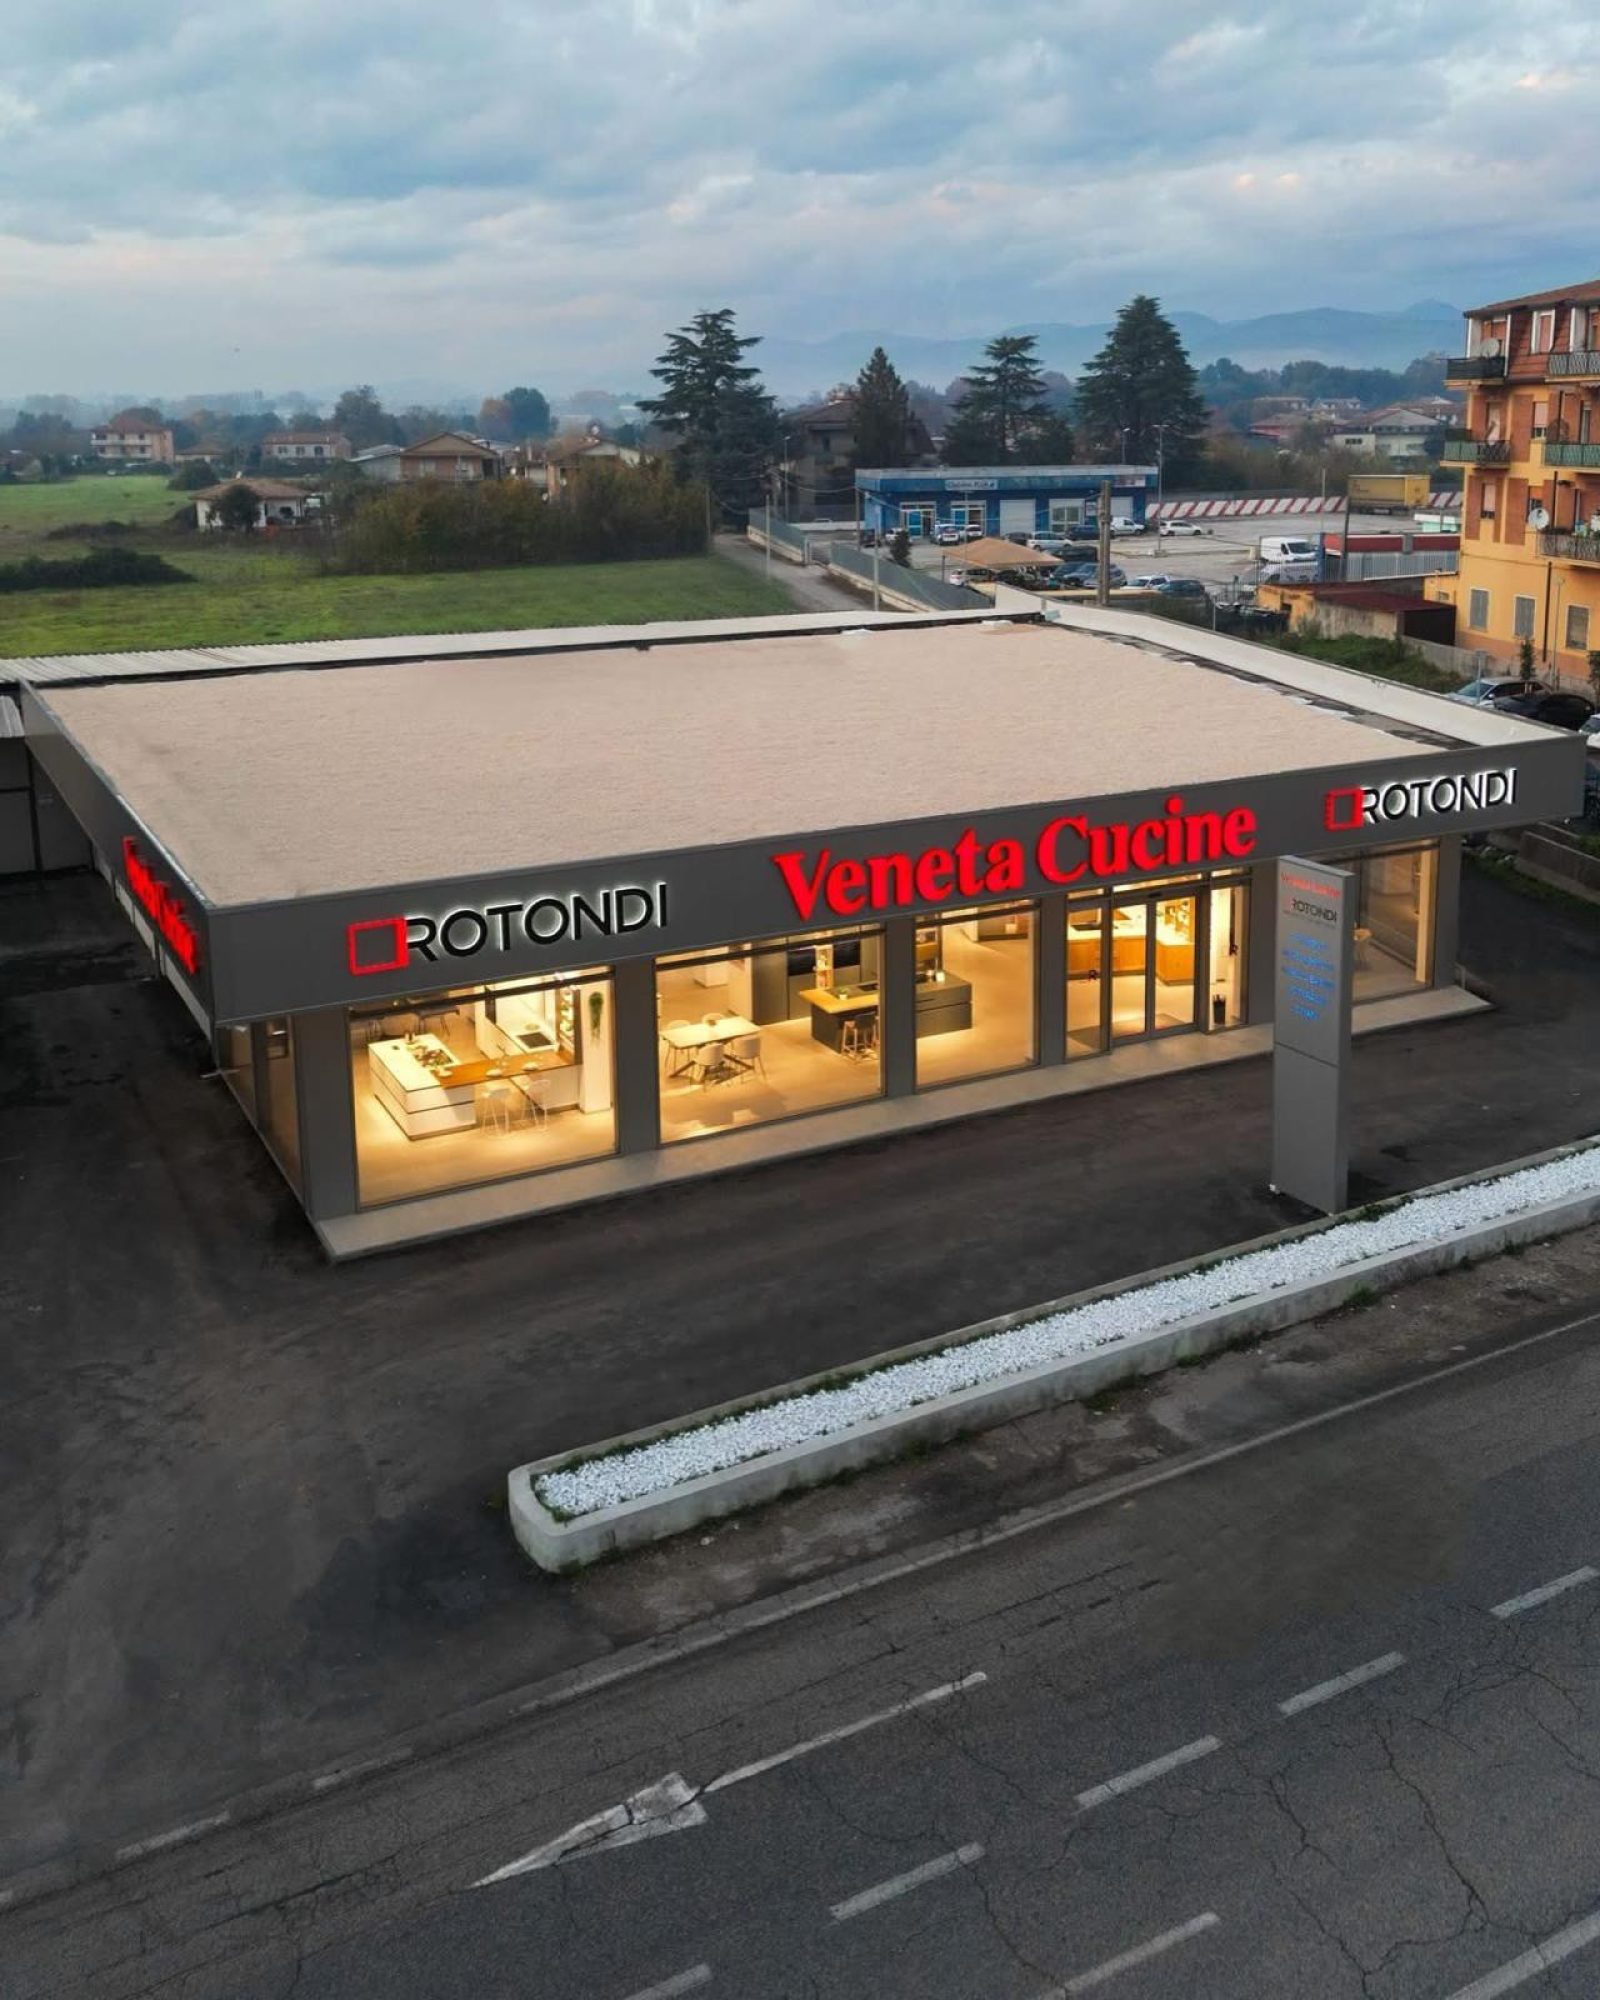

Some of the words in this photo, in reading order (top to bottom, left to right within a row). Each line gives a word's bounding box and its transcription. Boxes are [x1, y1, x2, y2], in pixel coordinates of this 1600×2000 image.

[1355, 767, 1518, 825] ROTONDI
[774, 827, 1025, 921] Veneta
[1037, 794, 1258, 884] Cucine
[398, 881, 667, 963] ROTONDI
